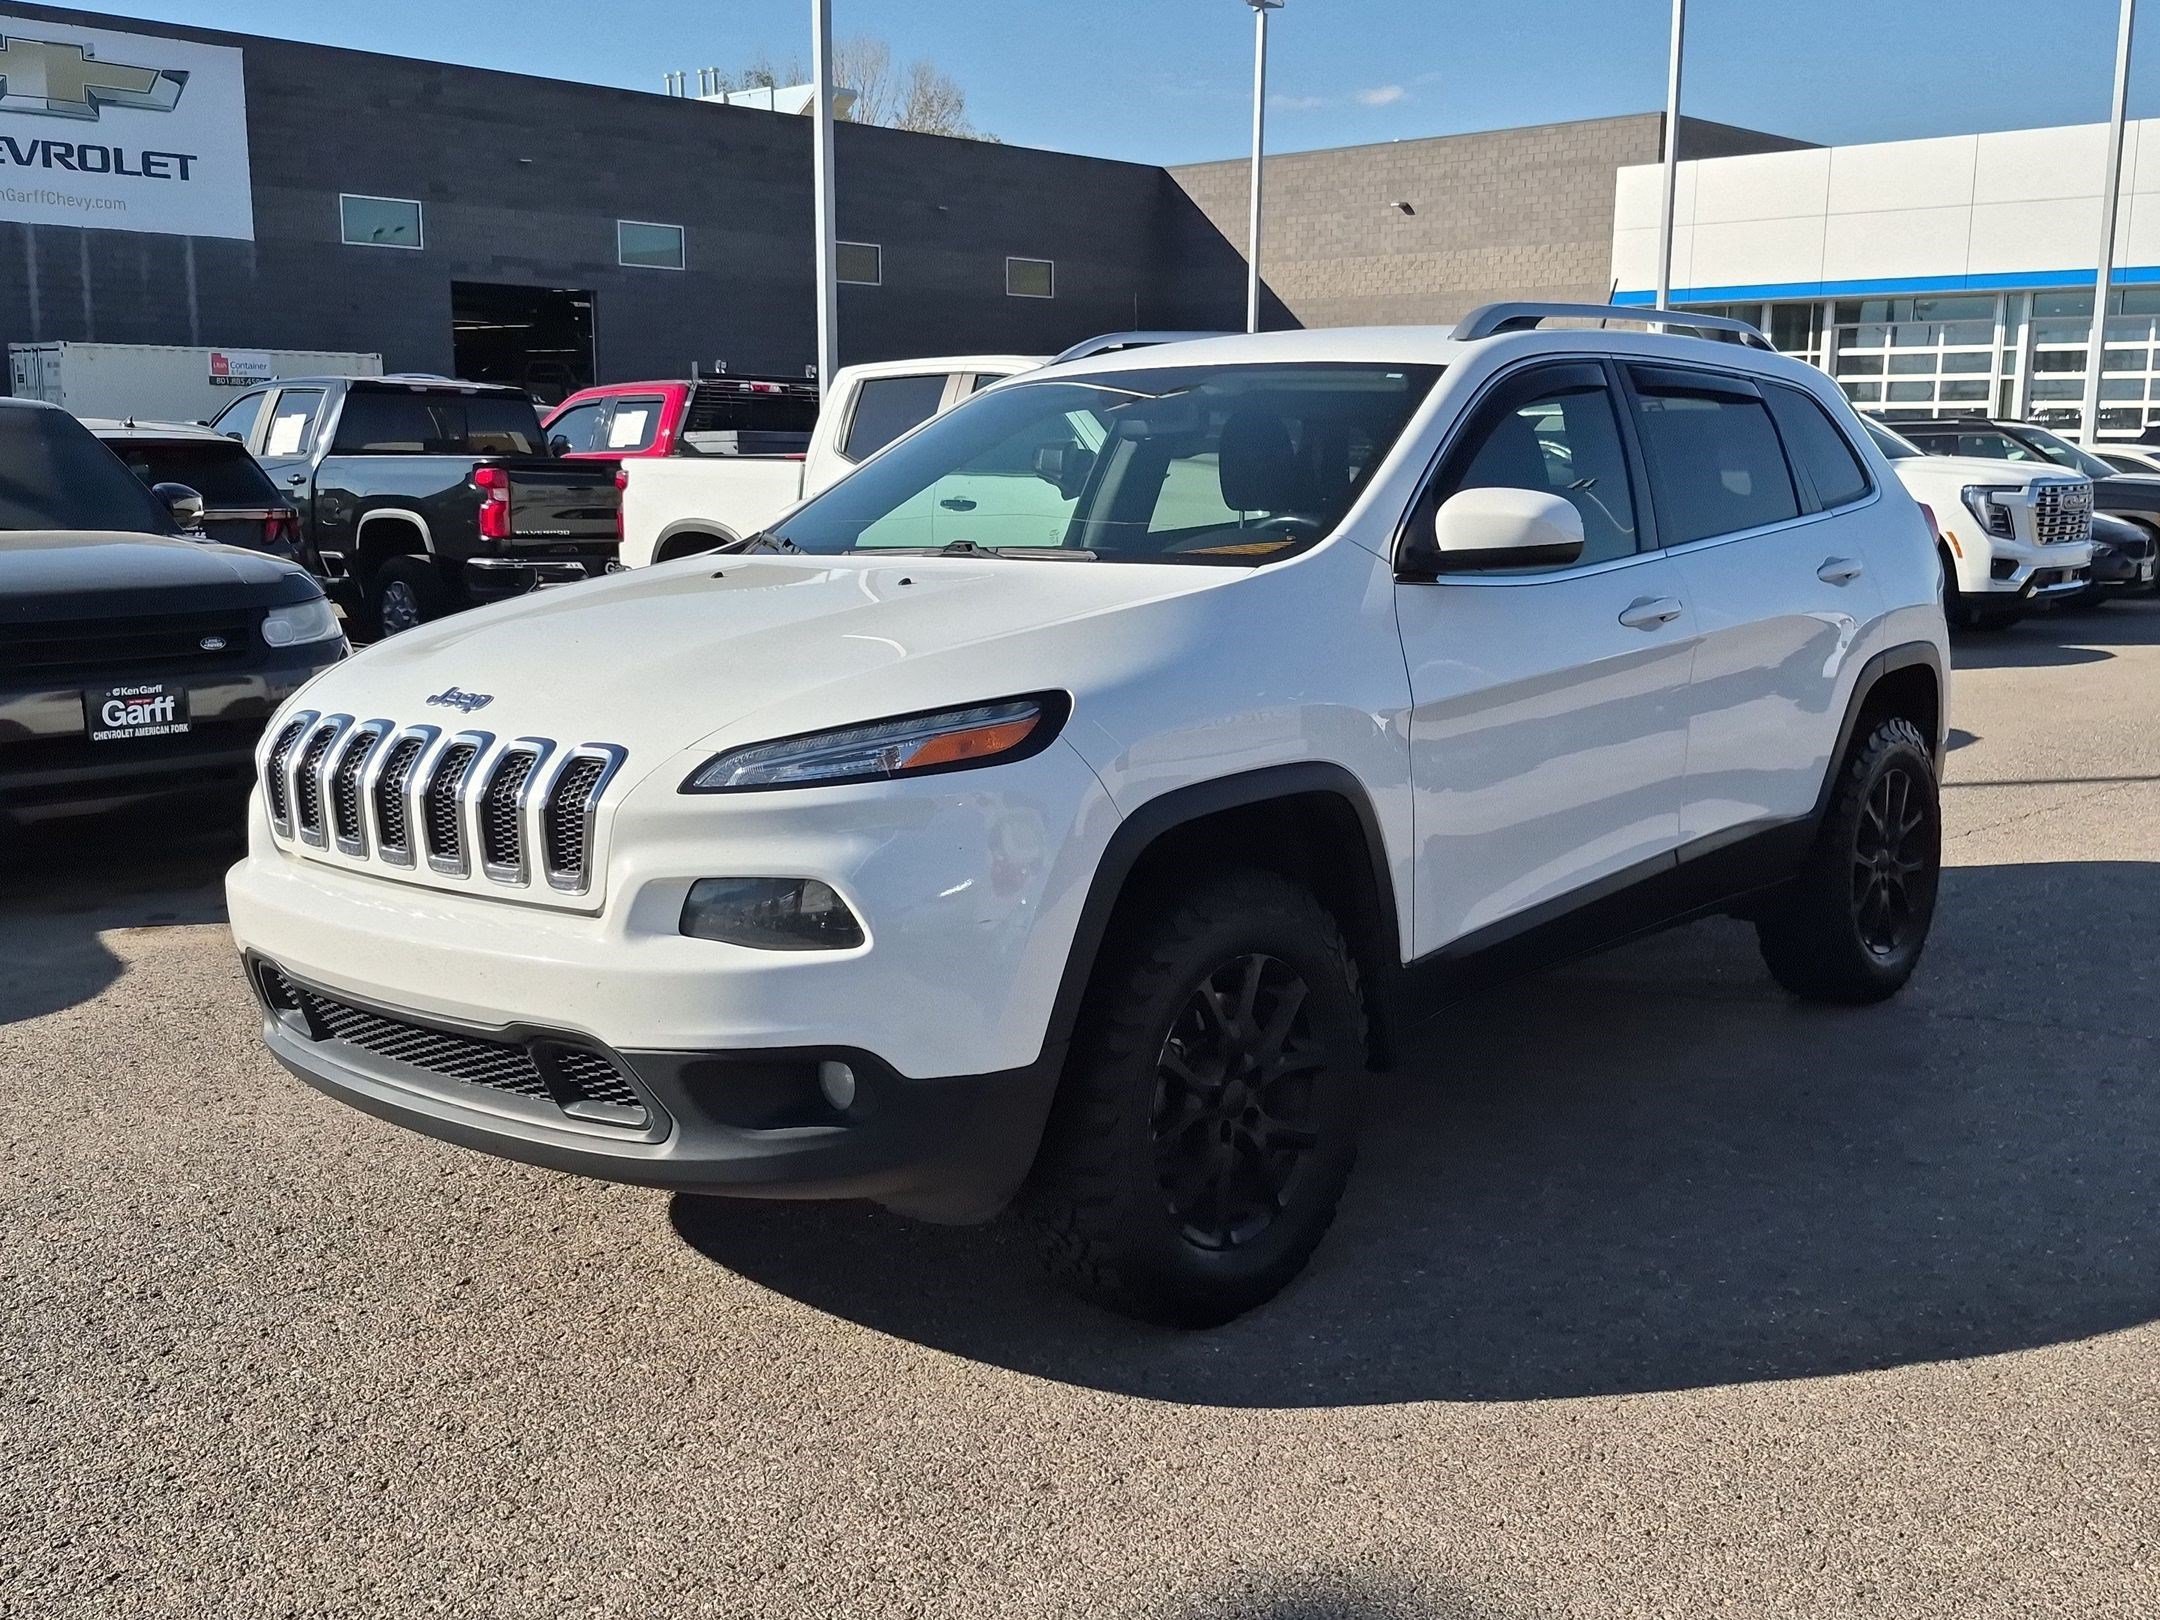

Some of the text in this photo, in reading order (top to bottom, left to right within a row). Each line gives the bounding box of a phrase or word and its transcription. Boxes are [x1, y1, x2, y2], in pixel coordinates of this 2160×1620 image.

[0, 135, 198, 181] VROLET
[230, 361, 267, 370] Container
[121, 684, 163, 696] Ken Garff
[425, 686, 495, 714] Jeep
[102, 695, 175, 727] Garff
[93, 723, 189, 741] CHEVROLET AMERICAN FORK
